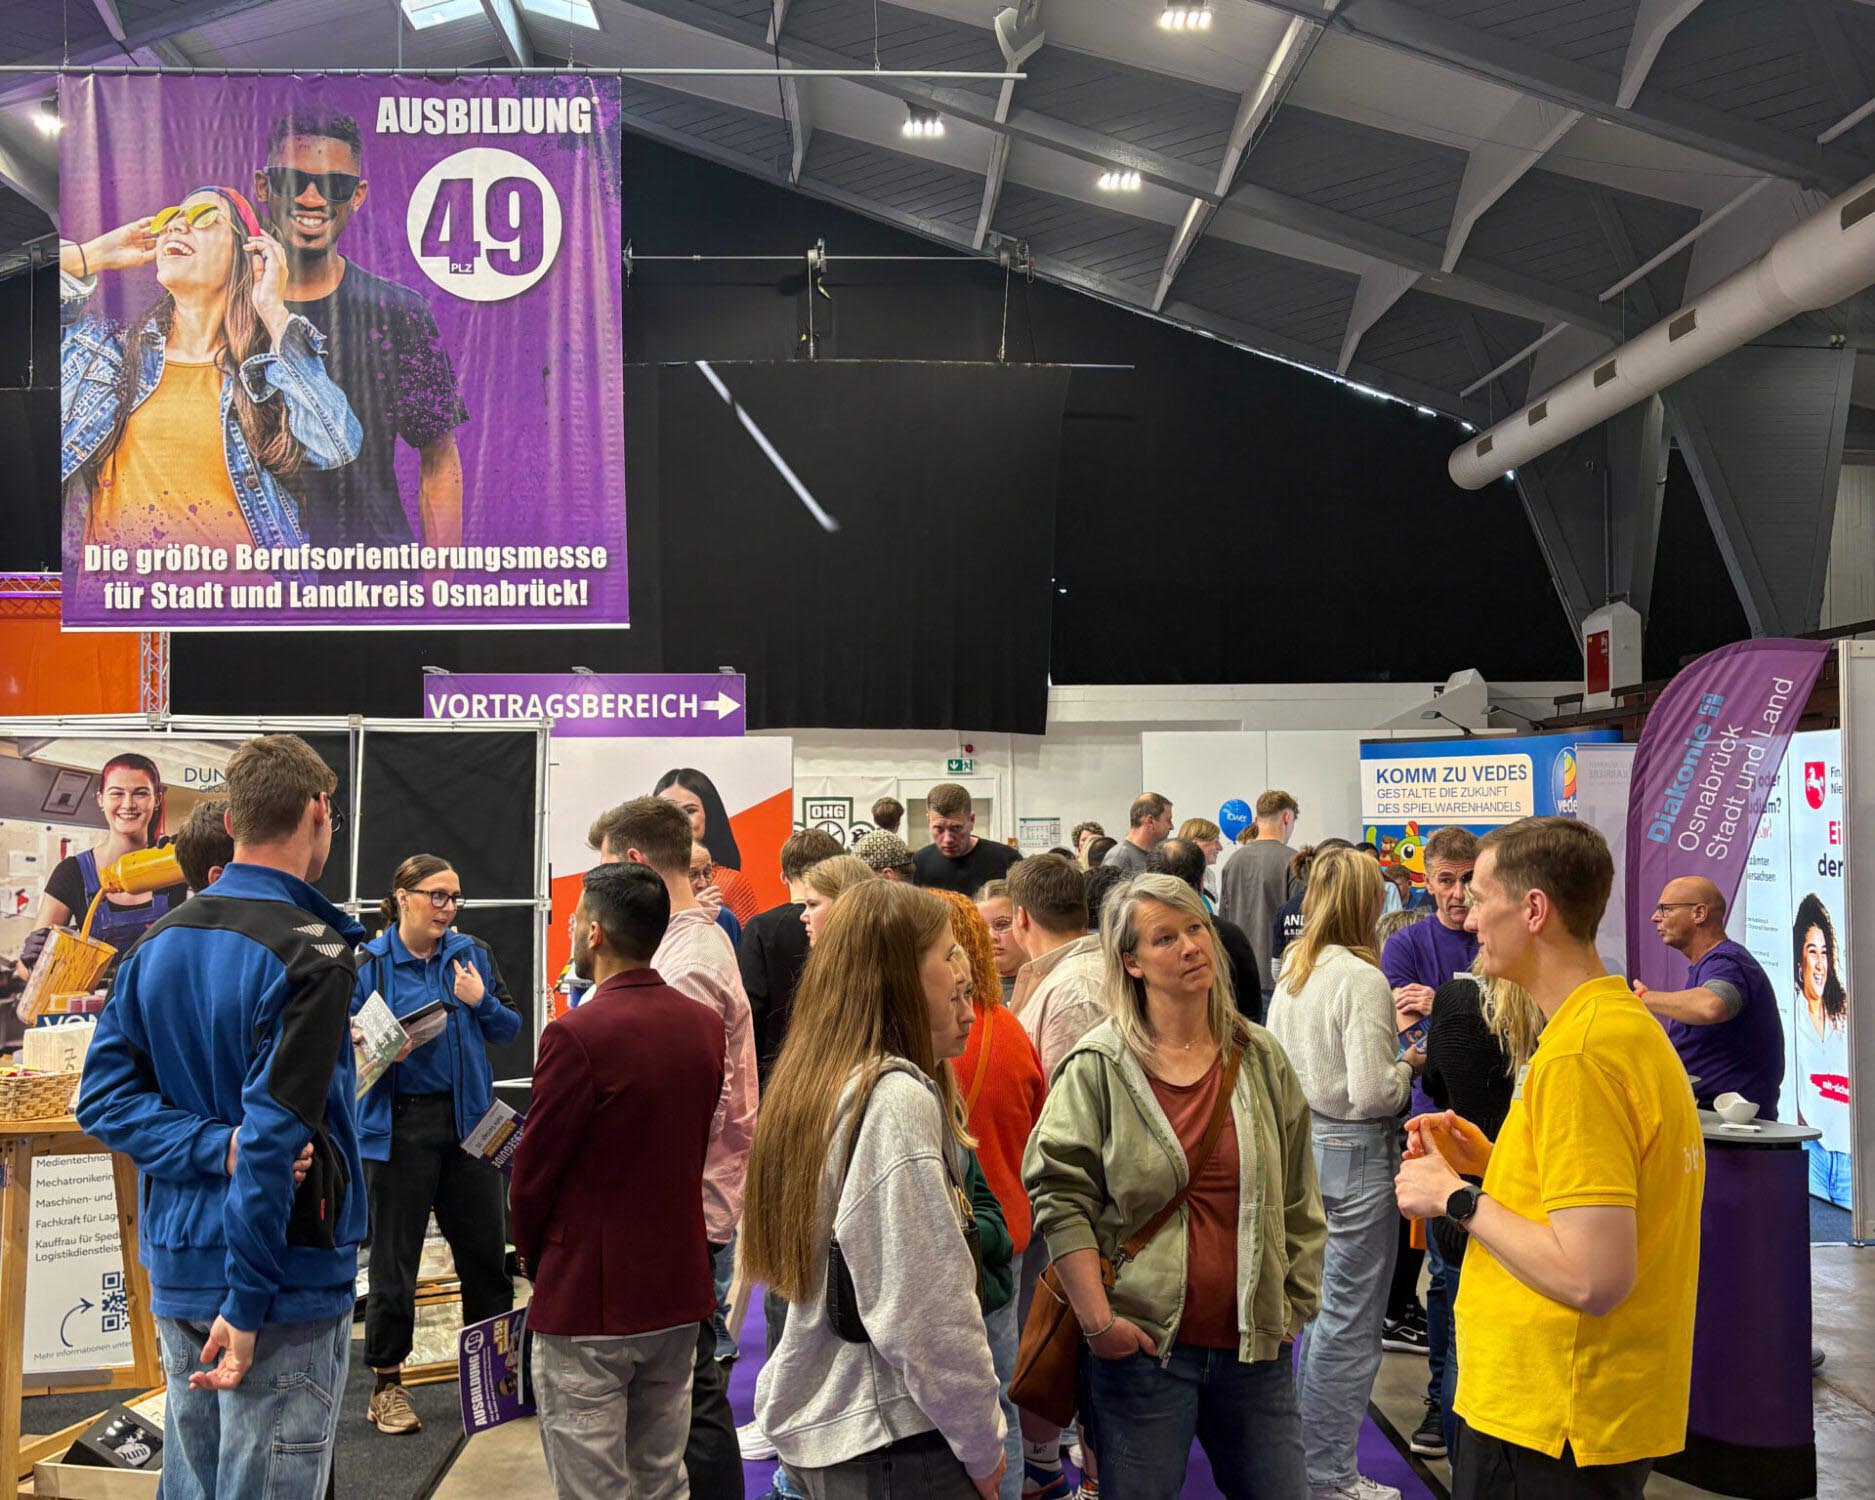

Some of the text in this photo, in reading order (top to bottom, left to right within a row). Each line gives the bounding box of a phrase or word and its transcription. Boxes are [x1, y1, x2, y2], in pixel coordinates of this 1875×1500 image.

[376, 96, 592, 135] AUSBILDUNG
[420, 176, 544, 276] 49
[450, 263, 473, 273] PLZ
[84, 541, 607, 575] Die größte Berufsorientierungsmesse
[103, 578, 588, 609] für Stadt und Landkreis Osnabrück!
[428, 693, 698, 719] VORTRAGSBEREICH
[1376, 764, 1527, 784] KOMM ZU VEDES
[1705, 677, 1794, 860] Stadt und Land
[1377, 785, 1508, 799] GESTALTE DIE ZUKUNFT
[1647, 722, 1711, 844] Diakonie
[1677, 724, 1743, 851] Osnabrück
[811, 805, 844, 818] OHG
[1377, 801, 1521, 813] DES SPIELWARENHANDELS
[1817, 853, 1844, 877] der
[491, 1123, 525, 1169] ESSEGUIDE
[36, 1192, 113, 1208] Maschinen- und
[36, 1215, 81, 1229] Fachkraft
[83, 1214, 96, 1224] für
[35, 1236, 77, 1249] Kauffrau
[79, 1234, 93, 1244] für
[34, 1352, 54, 1361] Mehr
[468, 1354, 488, 1427] AUSBILDUNG
